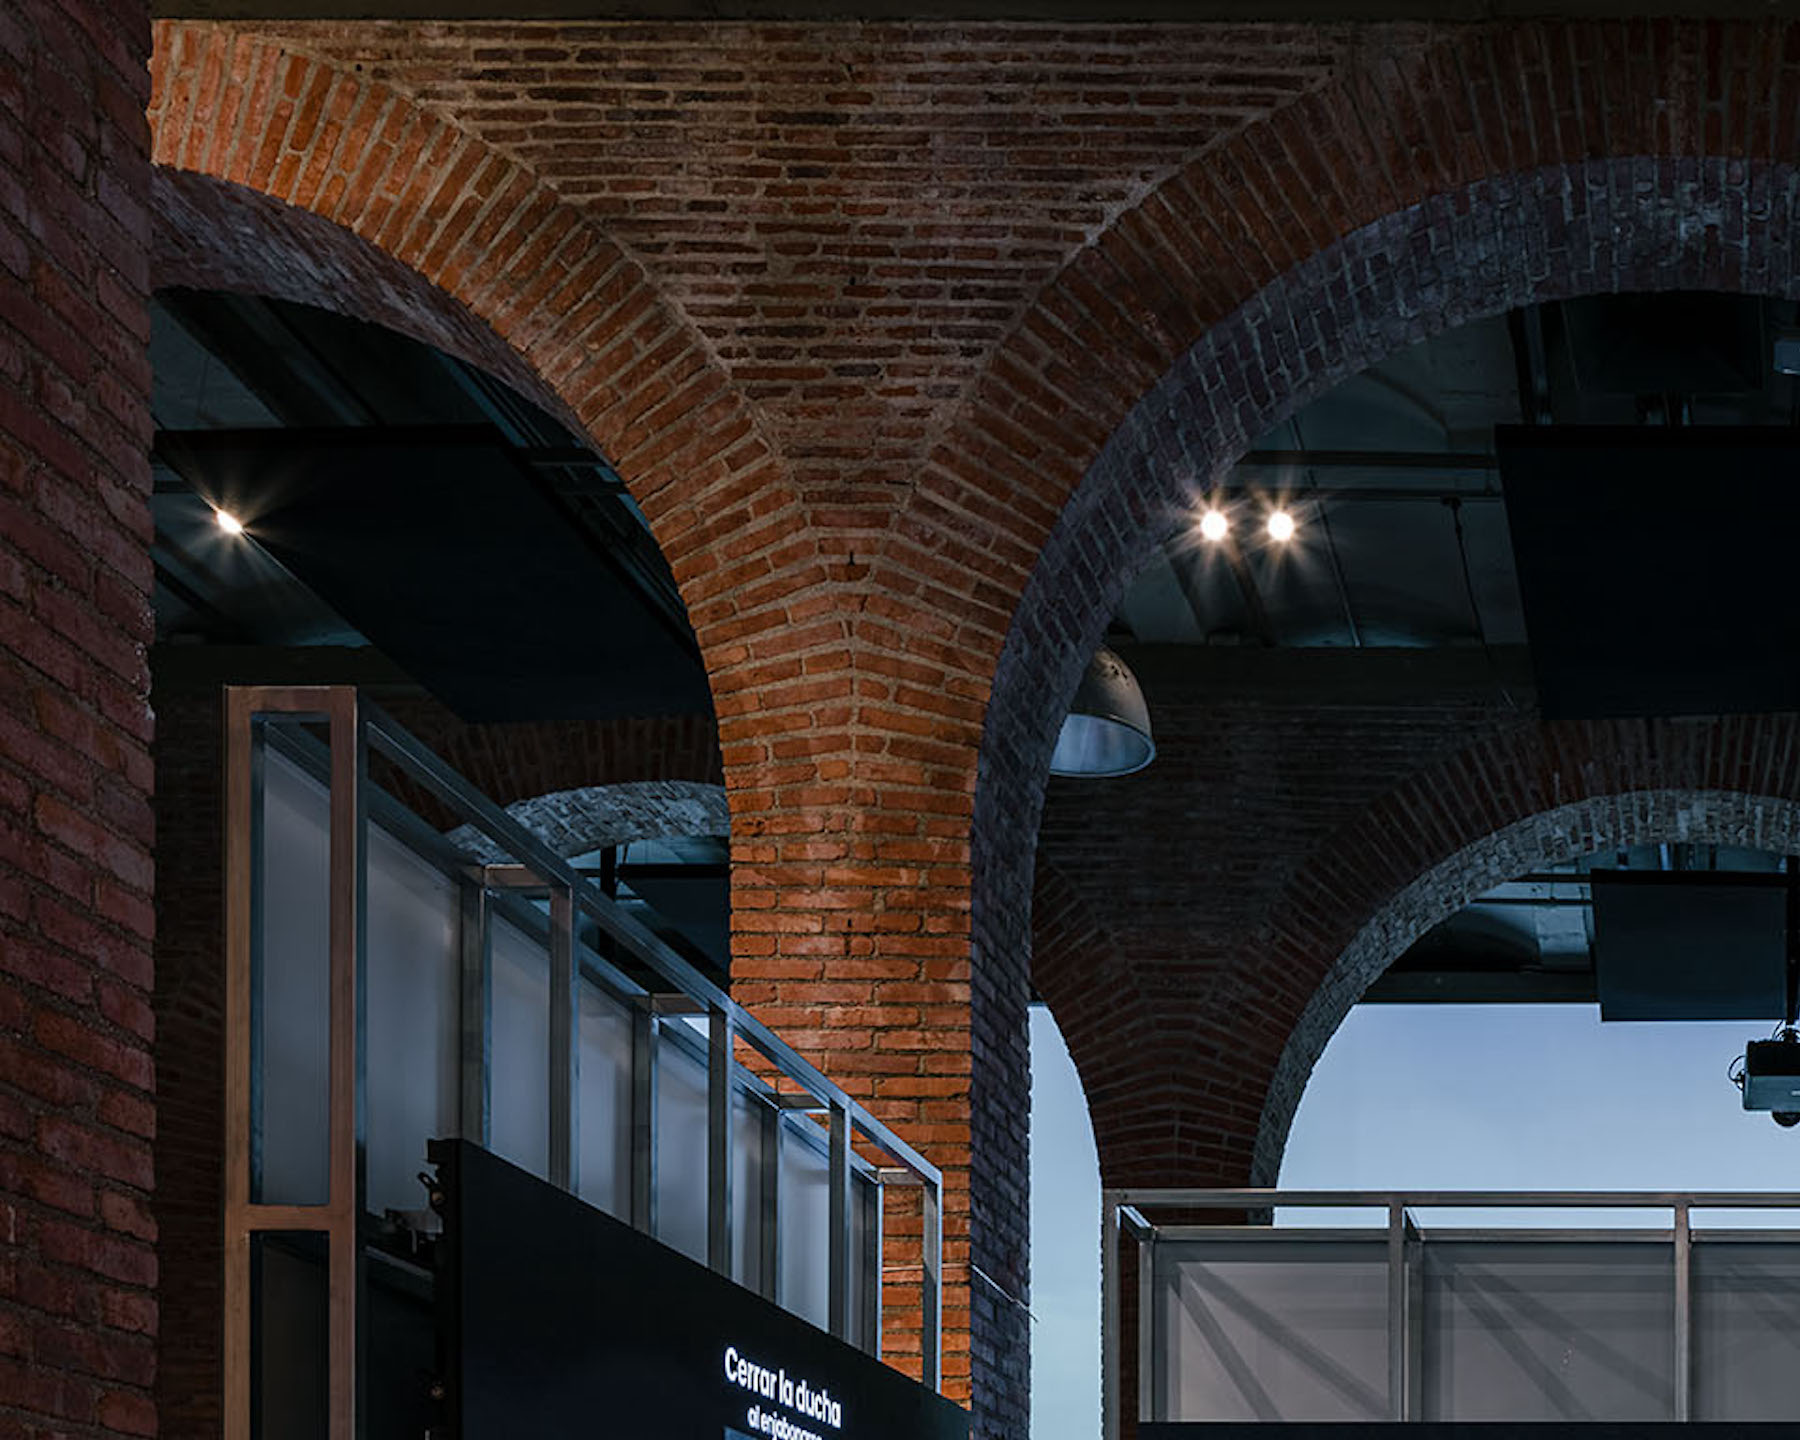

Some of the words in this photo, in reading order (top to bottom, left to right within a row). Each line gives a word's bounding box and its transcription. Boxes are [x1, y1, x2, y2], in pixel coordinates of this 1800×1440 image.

[725, 1347, 777, 1400] Cerrar
[778, 1369, 794, 1407] la
[796, 1379, 842, 1429] ducha
[747, 1405, 761, 1431] al
